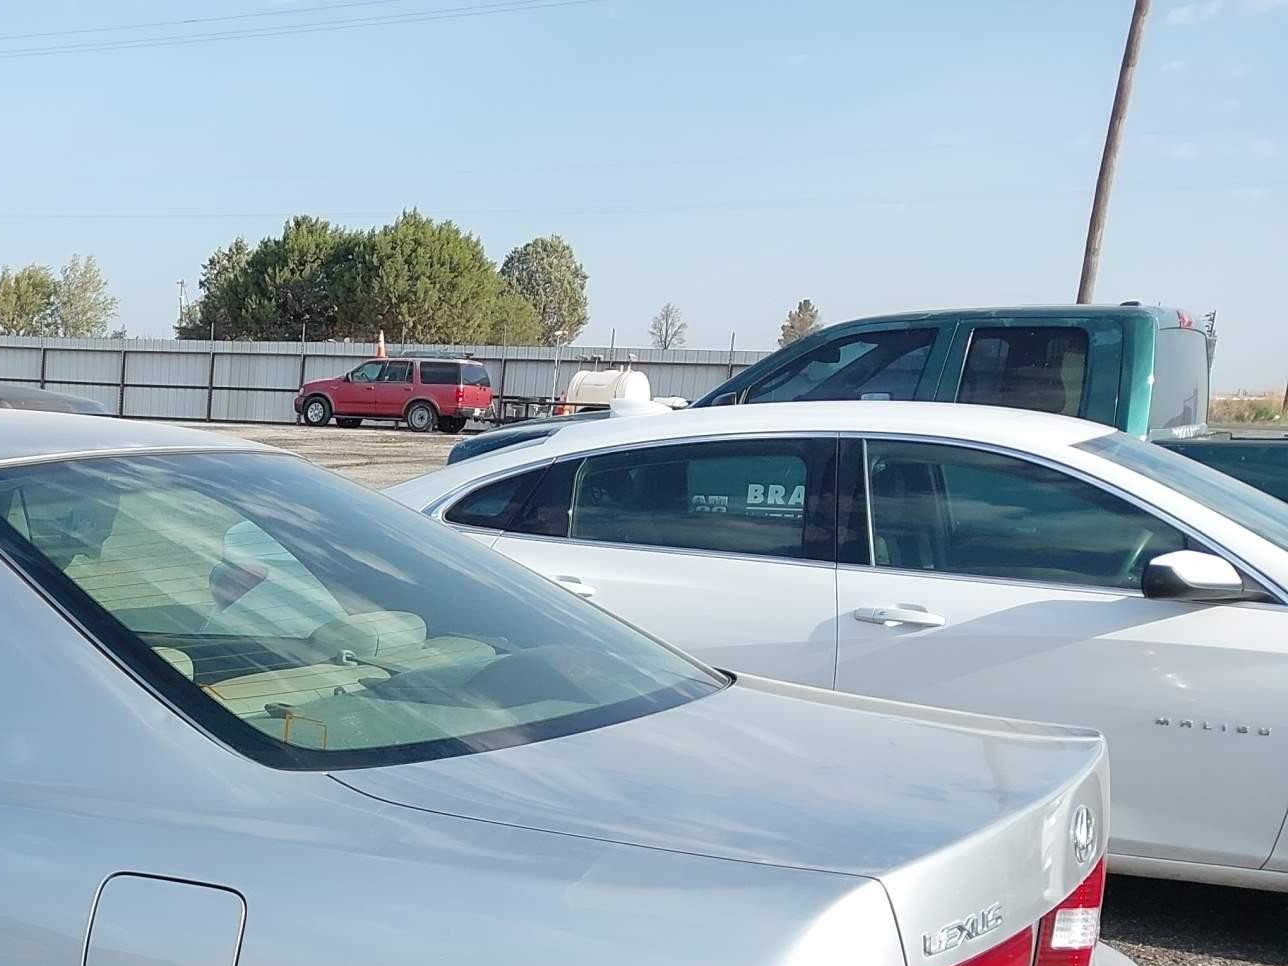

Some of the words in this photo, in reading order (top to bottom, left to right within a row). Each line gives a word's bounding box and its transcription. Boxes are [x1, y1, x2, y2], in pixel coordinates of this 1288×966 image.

[746, 483, 806, 505] BRA
[1154, 717, 1272, 736] MALIBU
[922, 901, 1003, 957] LEXUS
